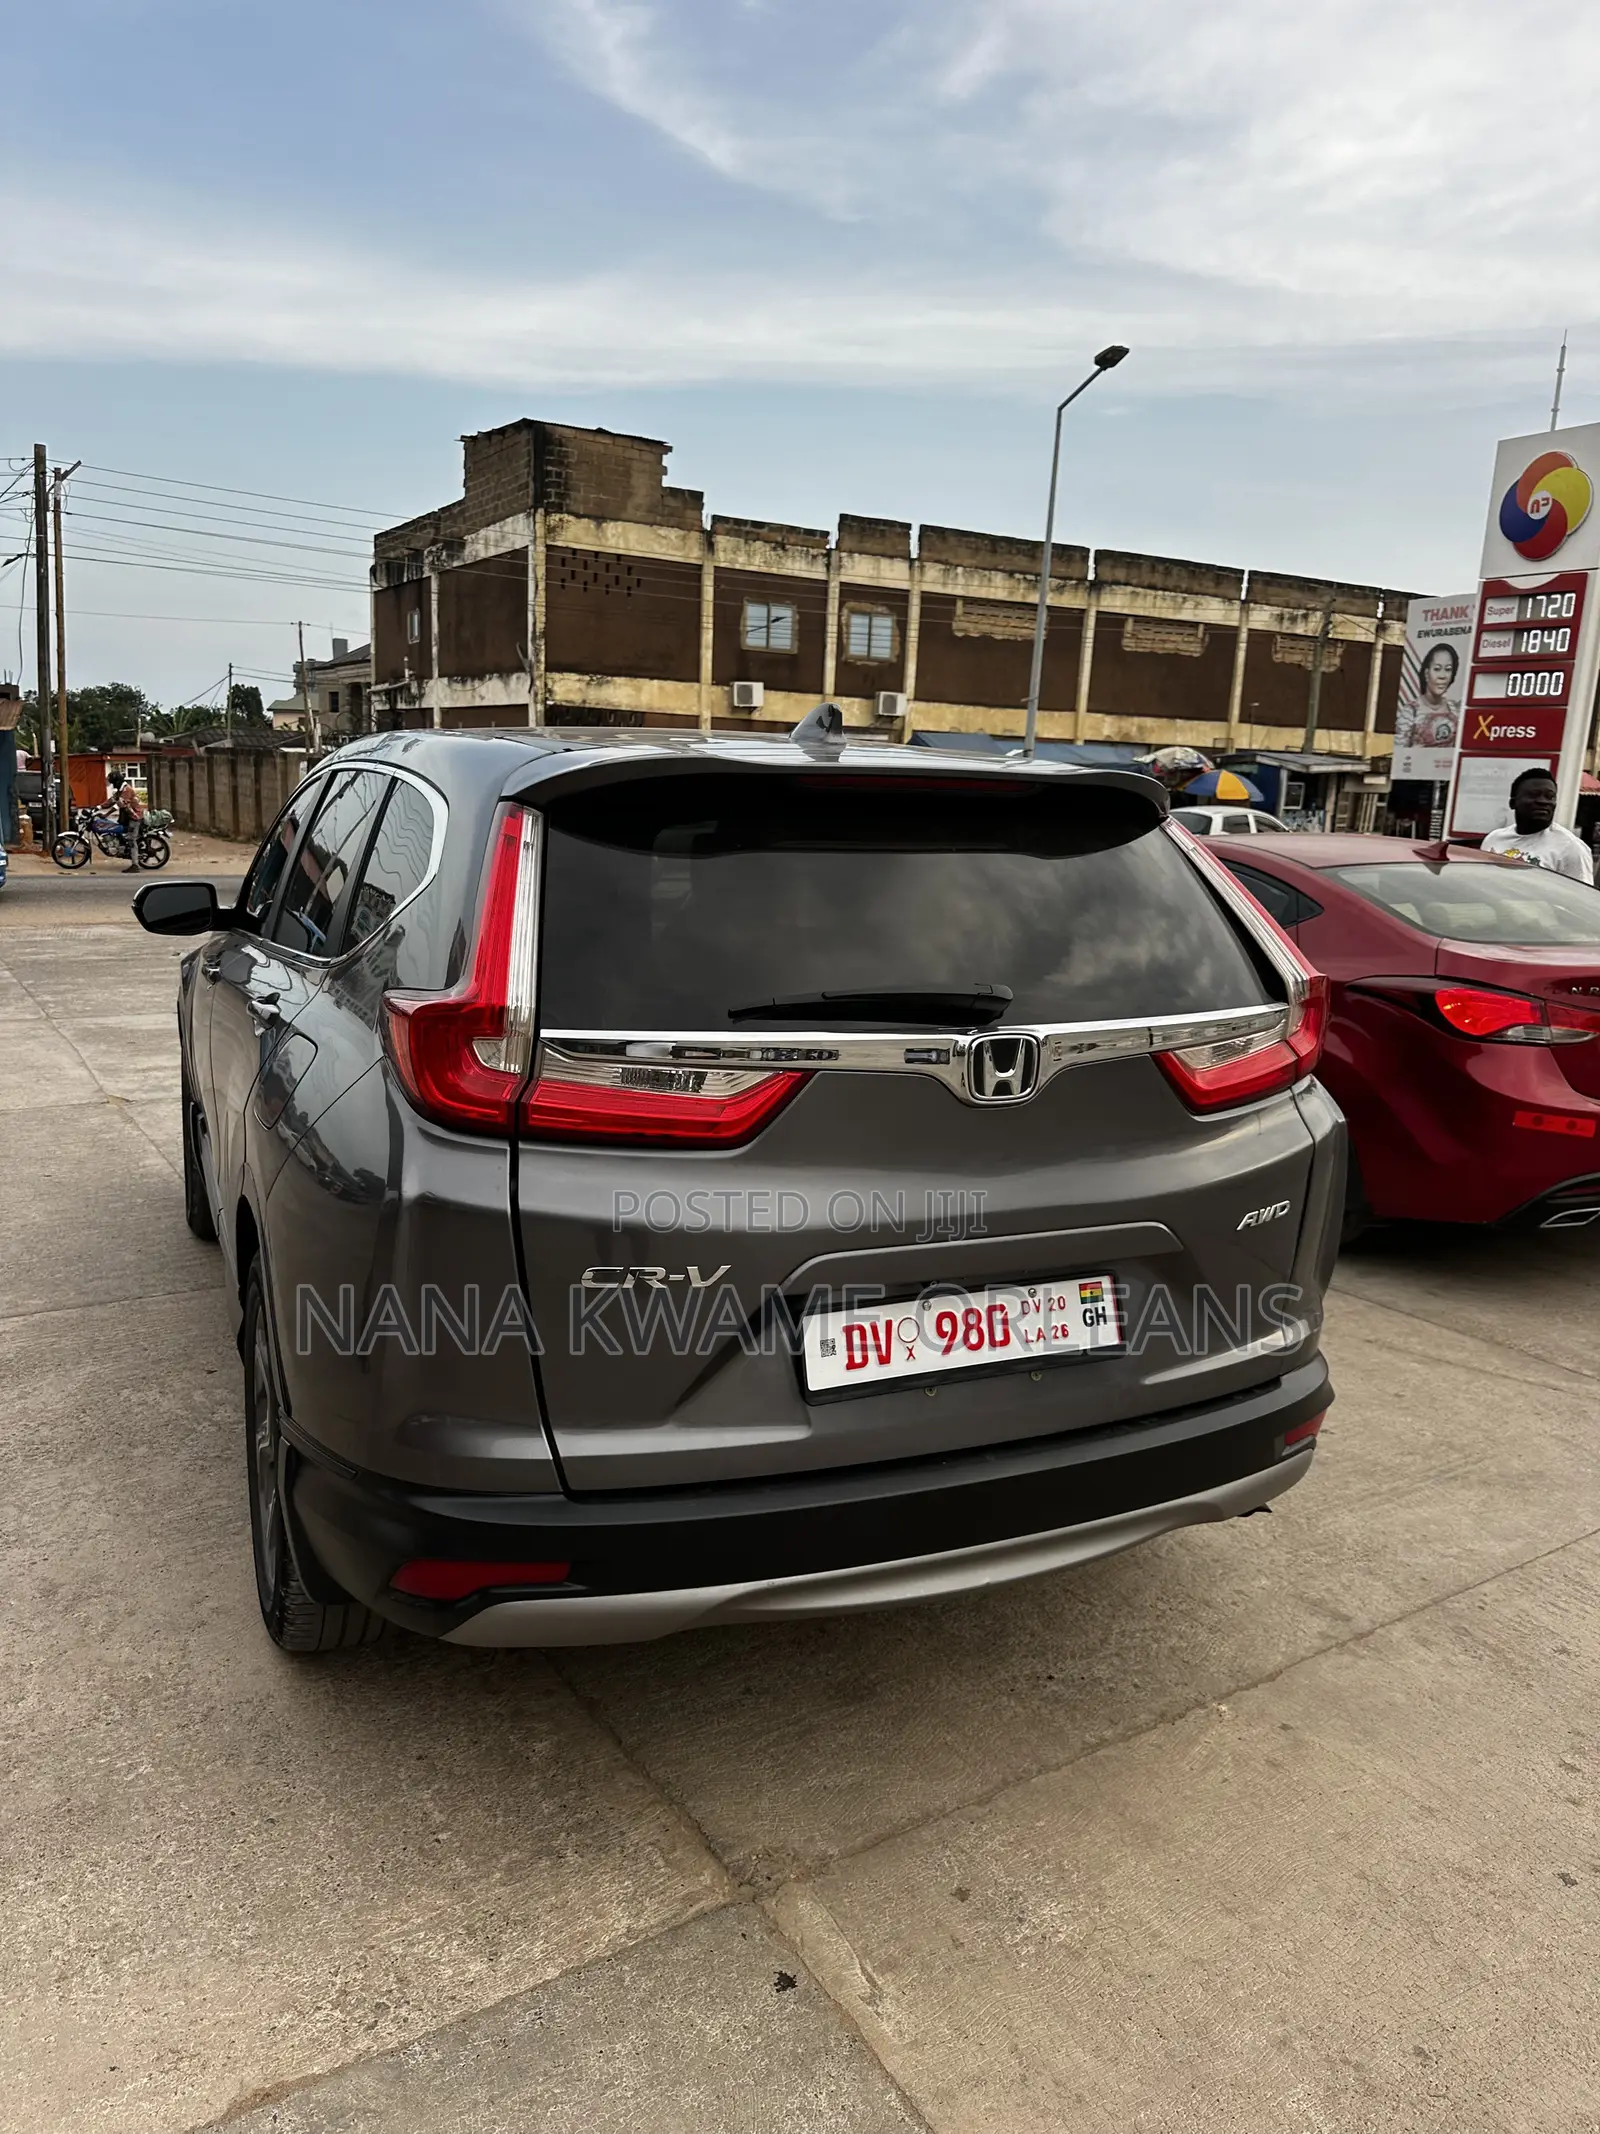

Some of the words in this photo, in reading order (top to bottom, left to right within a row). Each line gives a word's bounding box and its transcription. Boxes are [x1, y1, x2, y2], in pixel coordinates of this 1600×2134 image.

[1422, 604, 1470, 622] THANK
[1487, 604, 1515, 617] Super
[1526, 593, 1576, 618] 1720
[1482, 637, 1511, 649] Diesel
[1521, 627, 1571, 653] 1840
[1507, 672, 1564, 697] 0000
[1473, 715, 1536, 741] Xpress
[1236, 1200, 1291, 1231] AWD
[581, 1265, 732, 1288] CR-V
[1021, 1298, 1041, 1316] DV
[1048, 1296, 1066, 1311] 20
[1082, 1306, 1107, 1328] GH
[842, 1319, 893, 1371] DV
[1024, 1327, 1046, 1343] LA
[1052, 1324, 1069, 1339] 26
